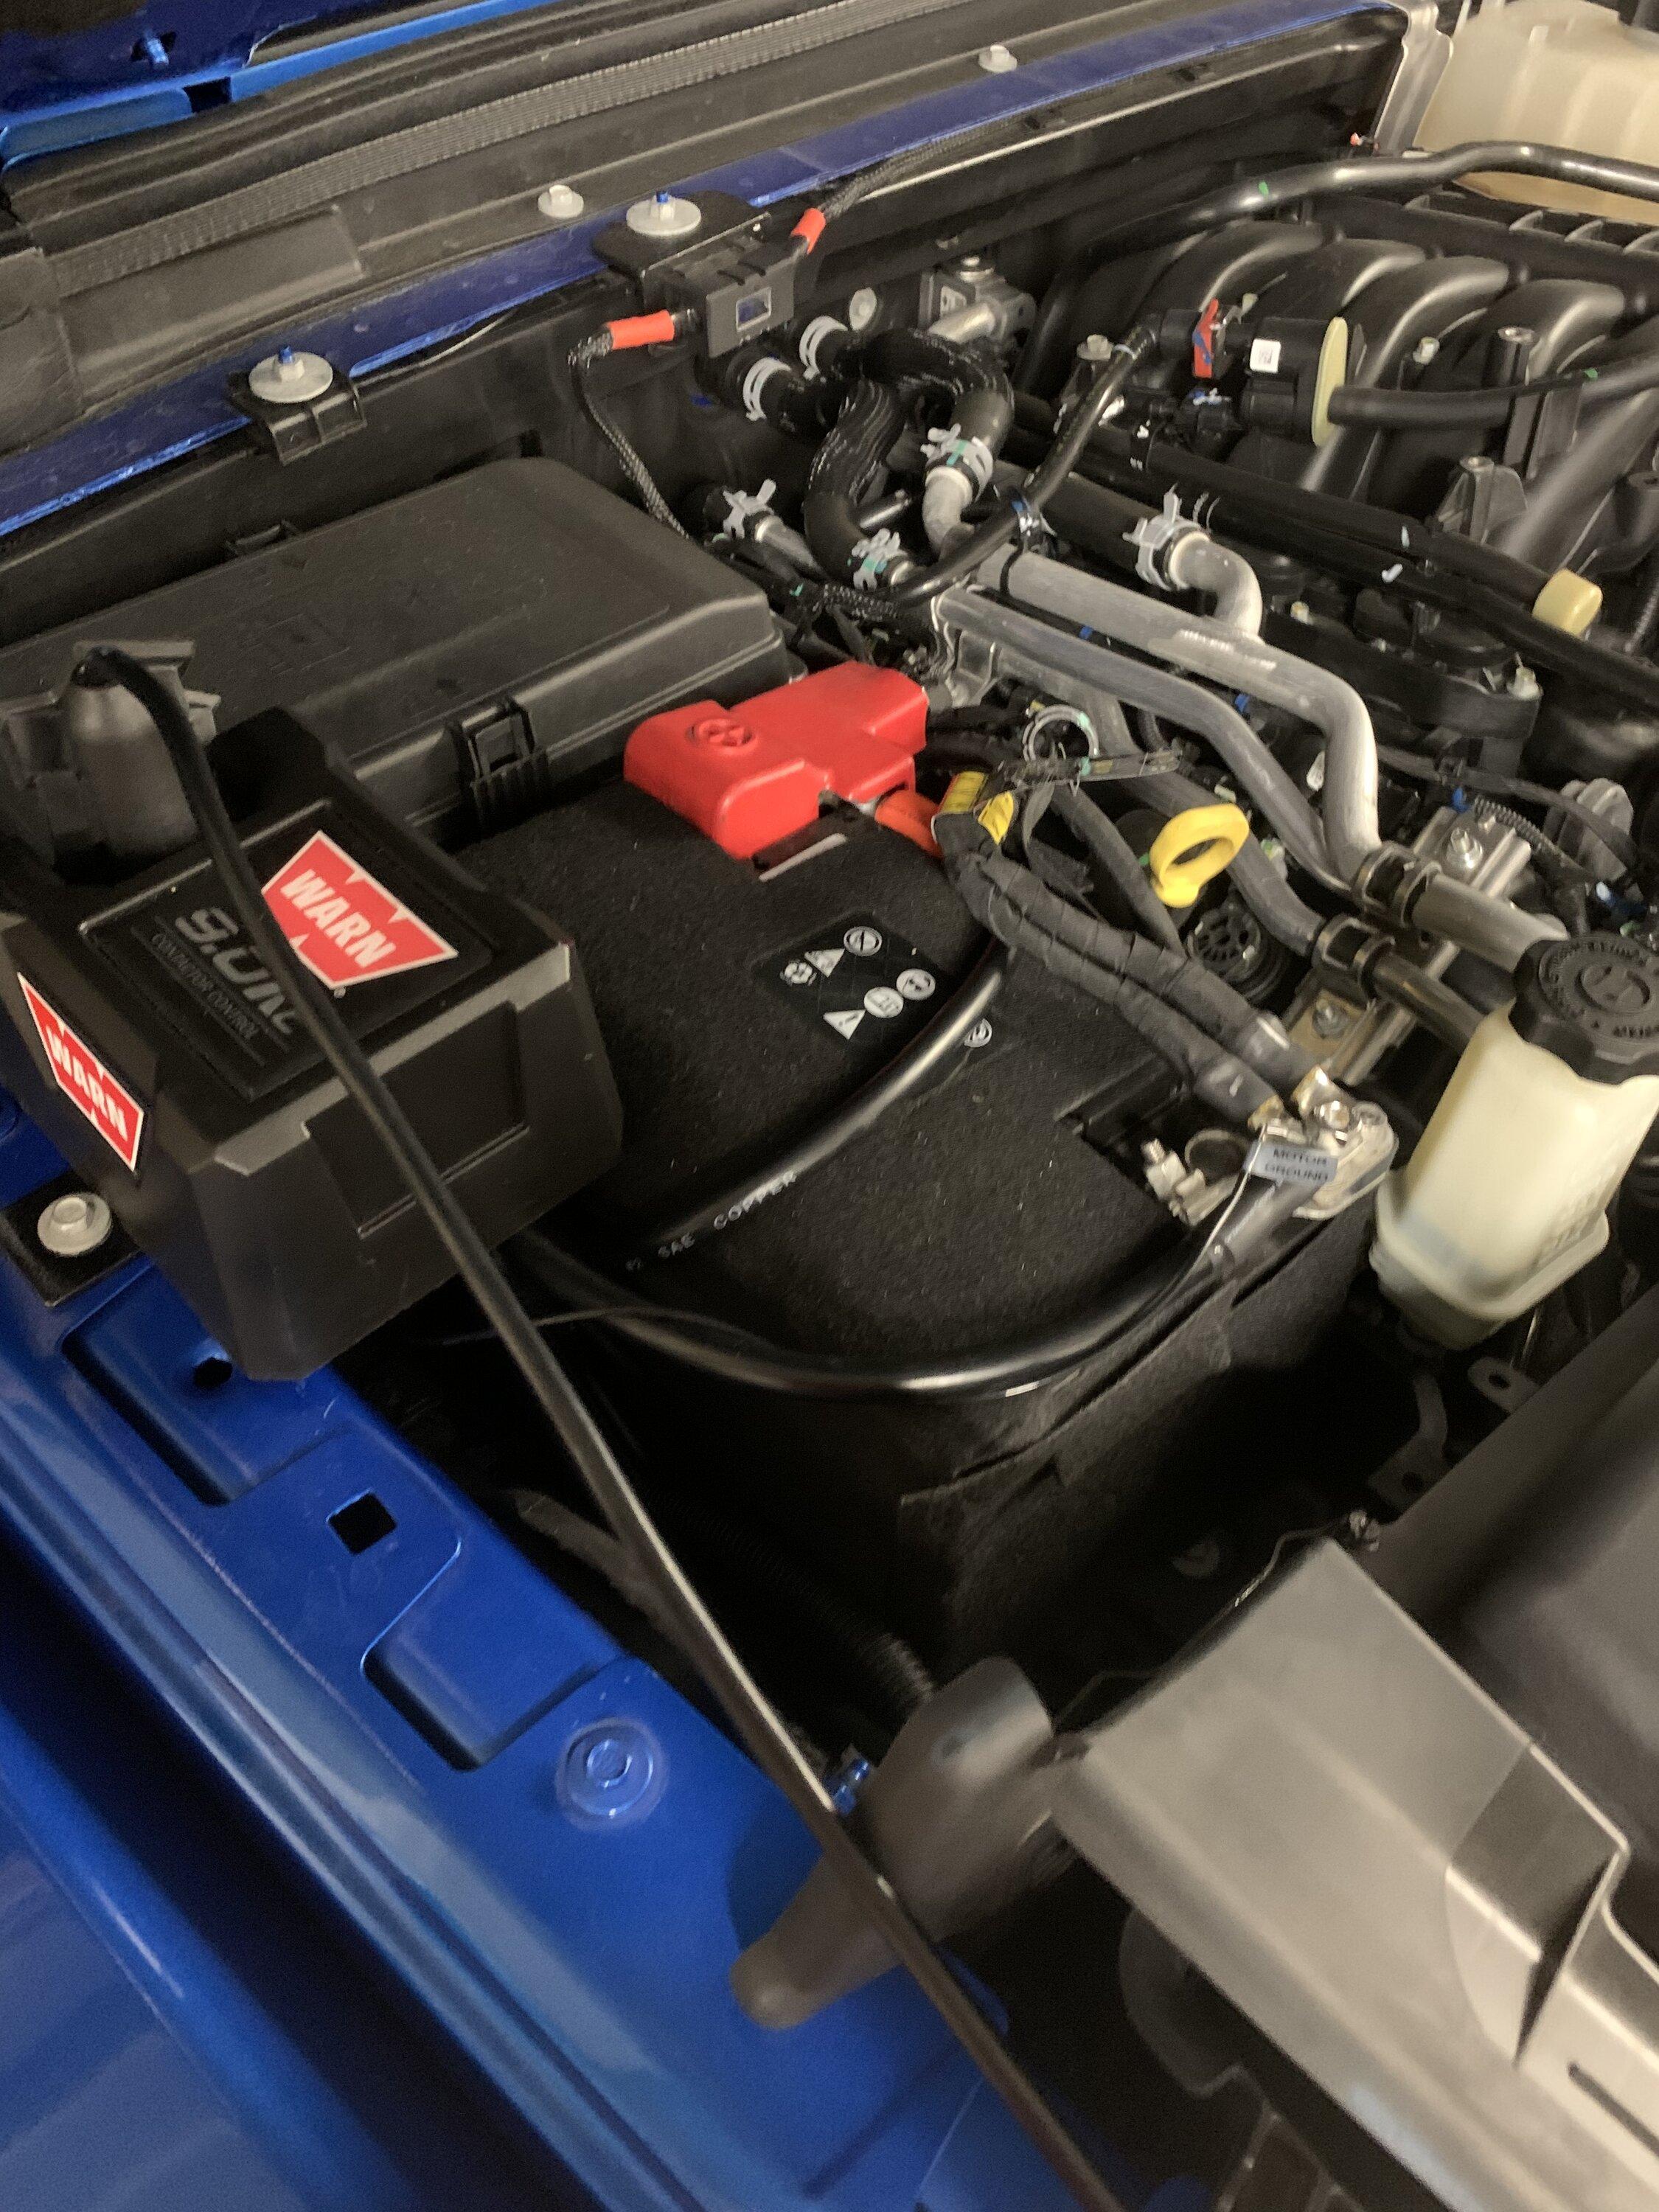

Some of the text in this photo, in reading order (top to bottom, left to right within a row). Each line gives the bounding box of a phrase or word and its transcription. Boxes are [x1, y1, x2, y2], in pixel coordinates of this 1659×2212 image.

[279, 868, 397, 968] WARN
[45, 1025, 128, 1142] WARN
[713, 1169, 797, 1231] COPPER
[1265, 1148, 1329, 1181] MOTOR GROUND
